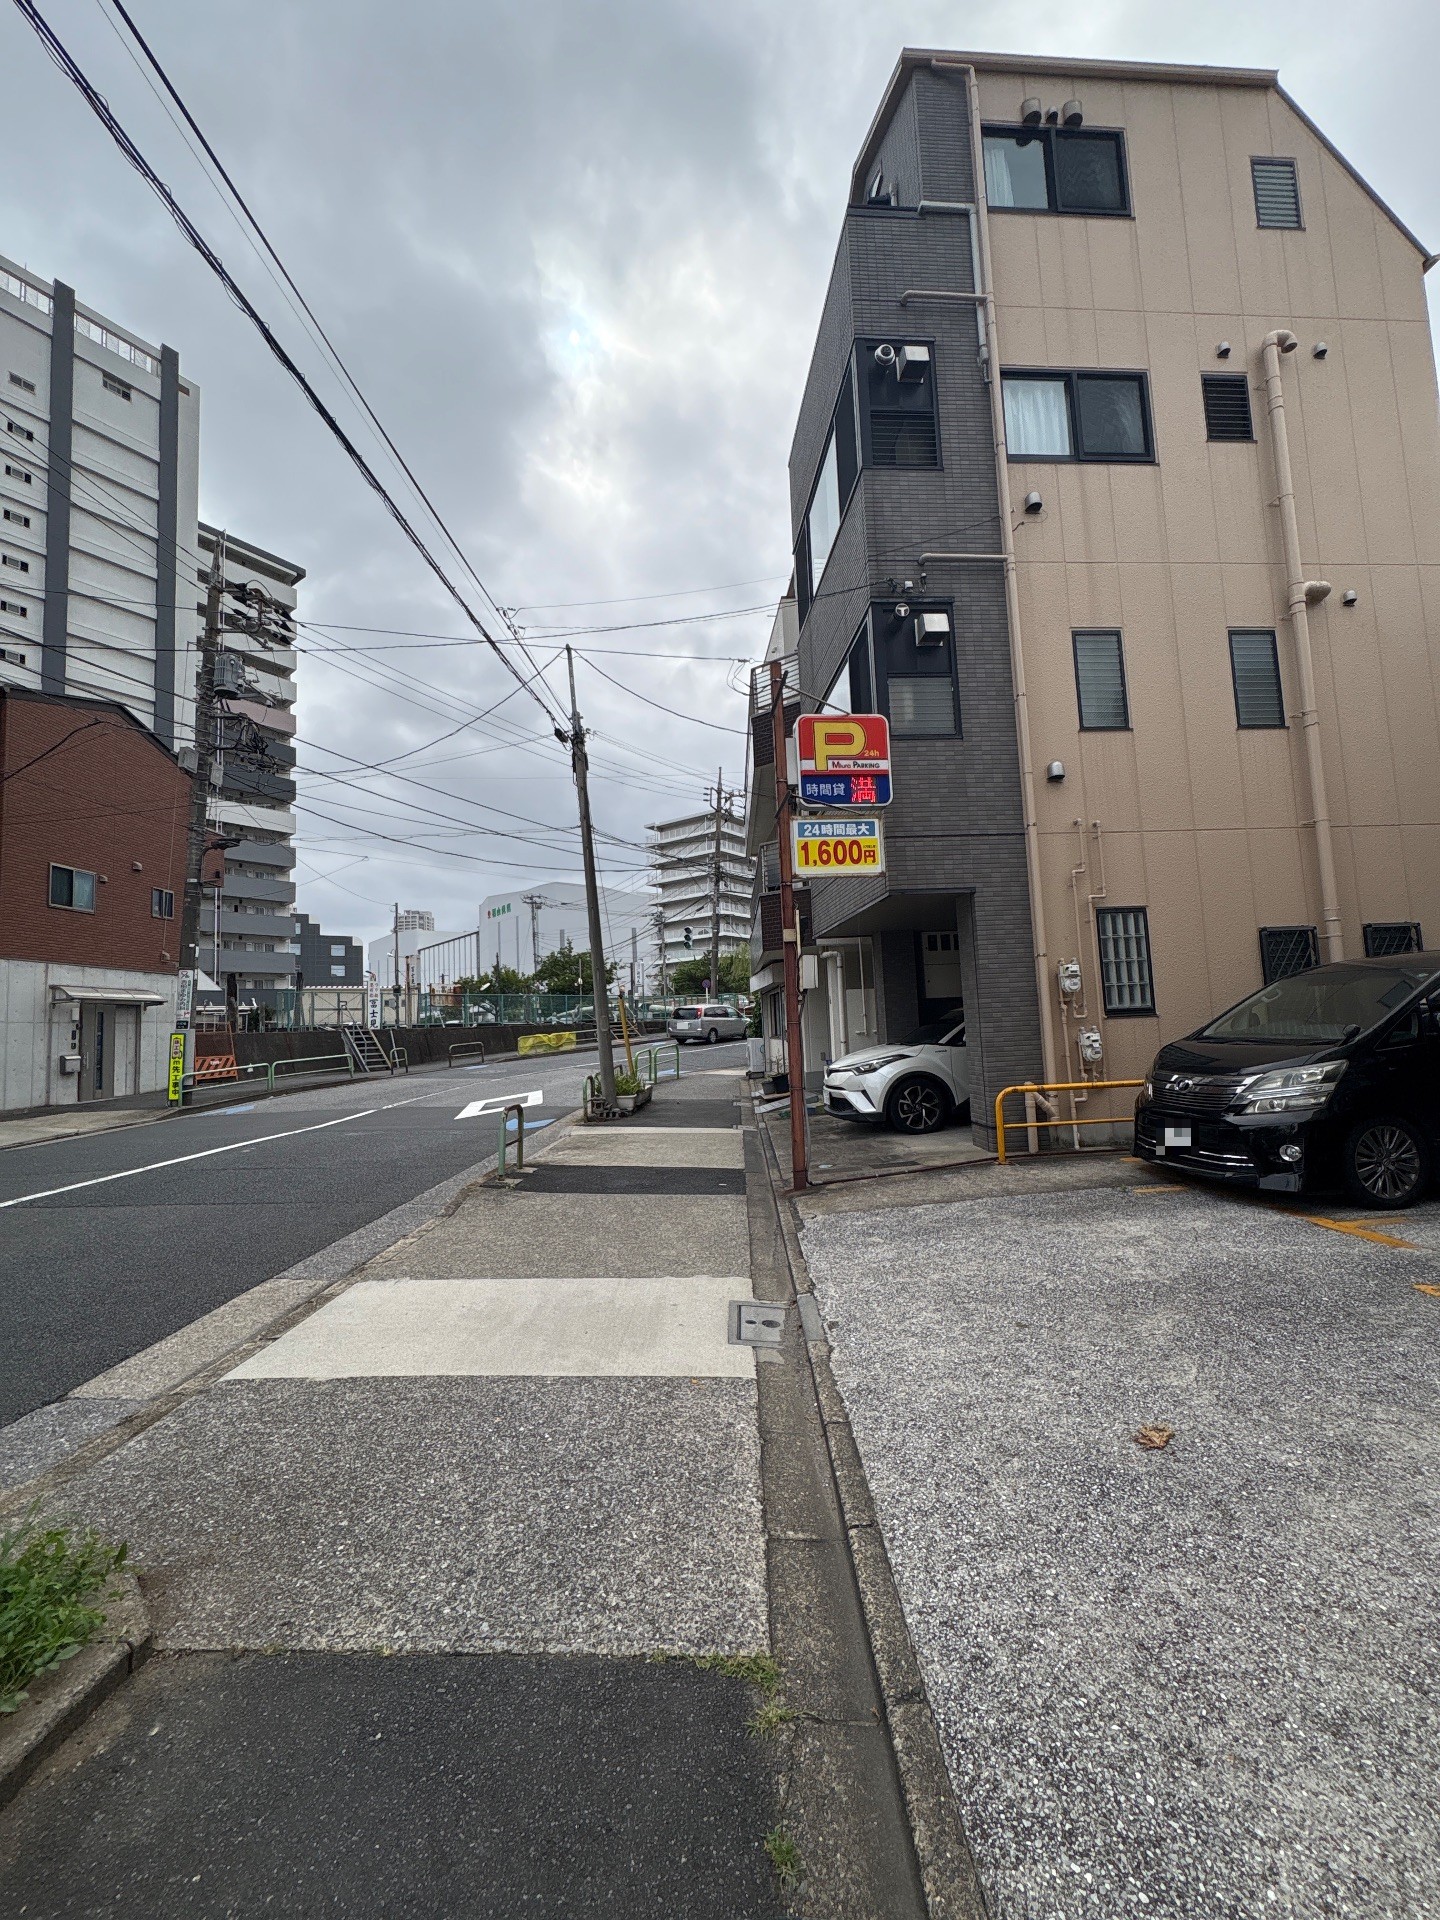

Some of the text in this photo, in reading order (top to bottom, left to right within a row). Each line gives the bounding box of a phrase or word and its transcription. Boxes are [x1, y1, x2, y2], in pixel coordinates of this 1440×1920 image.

[813, 721, 866, 772] P
[852, 761, 881, 769] PARKING
[806, 783, 846, 796] 時間貸
[850, 776, 877, 802] 満
[803, 823, 870, 836] 24時間最大
[800, 840, 877, 866] 1,600円
[369, 999, 379, 1029] 富士見
